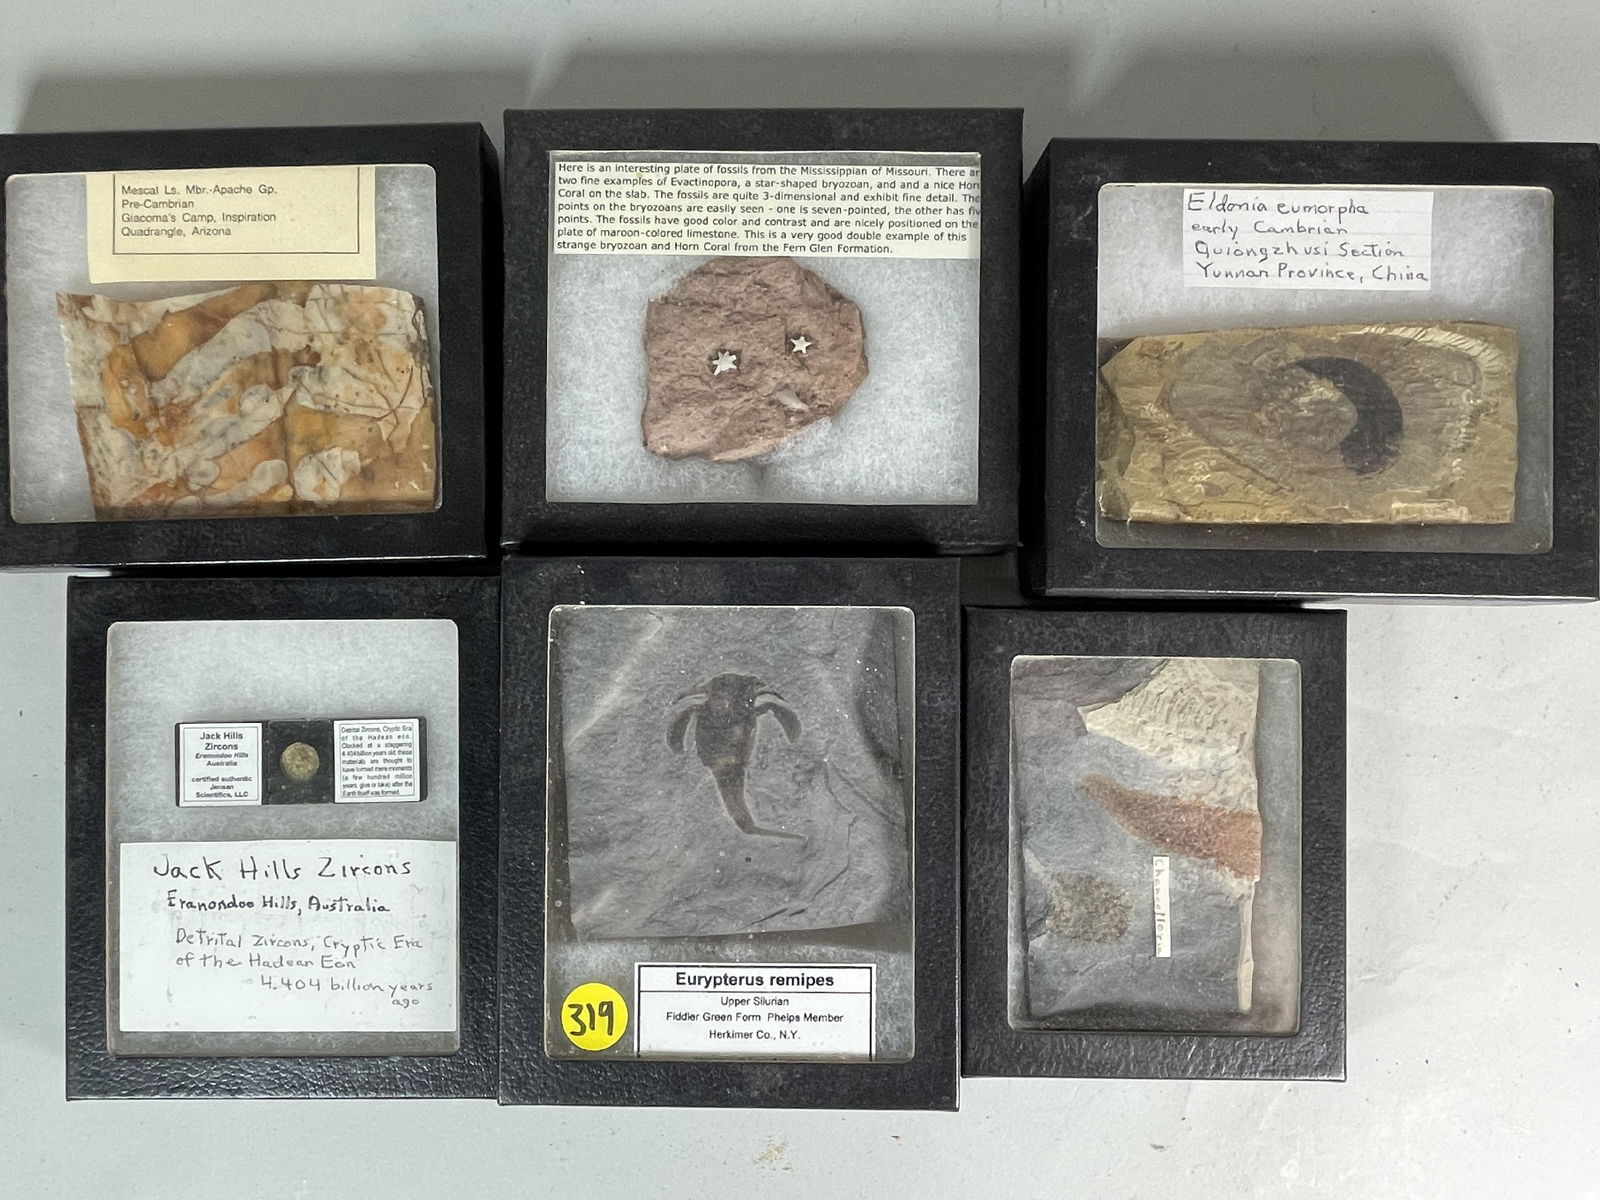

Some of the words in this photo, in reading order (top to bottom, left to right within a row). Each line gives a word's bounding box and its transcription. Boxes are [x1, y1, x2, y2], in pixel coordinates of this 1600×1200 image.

[557, 163, 583, 172] Here
[587, 163, 595, 172] is
[615, 163, 670, 175] interesting
[673, 164, 699, 174] plate
[703, 164, 713, 173] of
[717, 165, 748, 174] fossils
[752, 164, 776, 174] from
[779, 164, 797, 174] the
[800, 166, 867, 177] Mississippian
[871, 166, 881, 175] of
[885, 166, 930, 176] Missouri.
[935, 167, 965, 176] There
[121, 185, 158, 195] Mescal
[164, 185, 180, 194] Ls.
[186, 184, 252, 196] Mbr.-Apache
[258, 184, 277, 195] Gp.
[558, 176, 577, 184] two
[580, 176, 599, 184] fine
[603, 176, 652, 187] examples
[656, 177, 667, 186] of
[670, 177, 740, 188] Evactinopora,
[755, 178, 817, 190] star-shaped
[822, 179, 872, 190] bryozoan,
[876, 180, 895, 188] and
[900, 180, 919, 189] and
[934, 180, 954, 189] nice
[558, 188, 584, 197] Coral
[588, 190, 601, 198] on
[605, 189, 621, 198] the
[625, 189, 649, 198] slab.
[653, 189, 673, 198] The
[677, 190, 708, 199] fossils
[732, 191, 758, 202] quite
[762, 191, 835, 201] 3-dimensional
[840, 192, 859, 201] and
[863, 192, 898, 201] exhibit
[902, 193, 921, 202] fine
[926, 193, 957, 202] detail.
[1187, 190, 1267, 214] Eldonia
[121, 198, 194, 208] Pre-Cambrian
[558, 202, 589, 212] points
[609, 203, 626, 211] the
[630, 203, 682, 213] bryozoans
[706, 204, 736, 214] easily
[740, 205, 763, 213] seen
[776, 206, 795, 214] one
[800, 205, 808, 214] is
[811, 205, 889, 216] seven-pointed,
[894, 206, 911, 214] the
[915, 206, 942, 215] other
[946, 206, 964, 215] has
[121, 212, 176, 222] Giacoma's
[182, 212, 216, 223] Camp,
[222, 212, 276, 223] Inspiration
[557, 215, 591, 225] points.
[596, 215, 615, 223] The
[619, 215, 650, 224] fossils
[654, 216, 679, 224] have
[683, 216, 708, 227] good
[712, 216, 737, 225] color
[742, 217, 760, 226] and
[764, 218, 806, 226] contrast
[810, 218, 829, 227] and
[855, 218, 884, 229] nicely
[888, 218, 941, 229] positioned
[961, 219, 980, 228] the
[121, 226, 185, 239] Quadrangle,
[191, 226, 231, 236] Arizona
[557, 227, 583, 238] plate
[586, 227, 597, 236] of
[600, 228, 682, 238] maroon-colored
[687, 229, 739, 238] limestone.
[744, 229, 764, 238] This
[768, 230, 776, 238] is
[791, 232, 813, 241] very
[817, 230, 842, 242] good
[846, 230, 881, 240] double
[885, 231, 929, 242] example
[933, 231, 944, 240] of
[947, 232, 966, 241] this
[1191, 220, 1237, 240] early
[557, 240, 596, 251] strange
[600, 240, 647, 251] bryozoan
[651, 241, 670, 250] and
[674, 241, 699, 250] Horn
[703, 242, 729, 251] Coral
[734, 242, 758, 251] from
[762, 243, 778, 251] the
[783, 243, 805, 252] Fern
[809, 243, 832, 252] Glen
[837, 243, 892, 253] Formation.
[1337, 241, 1404, 257] Section
[1195, 261, 1269, 278] Yunnan
[1278, 262, 1363, 283] Province,
[1372, 264, 1428, 282] China
[204, 742, 238, 750] Zircons
[153, 855, 222, 881] Jack
[240, 855, 300, 880] Hills
[318, 855, 410, 877] Zircons
[262, 895, 301, 915] Hills,
[308, 895, 390, 913] Australia
[175, 929, 241, 949] Detrital
[252, 932, 316, 951] Zircons,
[323, 935, 386, 956] Cryptic
[393, 934, 423, 949] Era
[176, 953, 194, 967] of
[199, 954, 242, 968] the
[249, 953, 313, 968] Hadean
[320, 953, 357, 969] Eon
[260, 976, 320, 990] 4.404
[330, 976, 384, 991] billion
[389, 980, 433, 997] years
[676, 972, 763, 988] Eurypterus
[770, 972, 834, 988] remipes
[391, 998, 419, 1008] ago
[720, 996, 750, 1007] Upper
[753, 996, 788, 1006] Silurian
[567, 1000, 614, 1036] 319
[666, 1012, 699, 1021] Fiddler
[702, 1012, 732, 1021] Green
[768, 1012, 800, 1023] Phelps
[804, 1012, 843, 1022] Member
[709, 1029, 752, 1039] Herkimer
[779, 1030, 800, 1039] N.Y.
